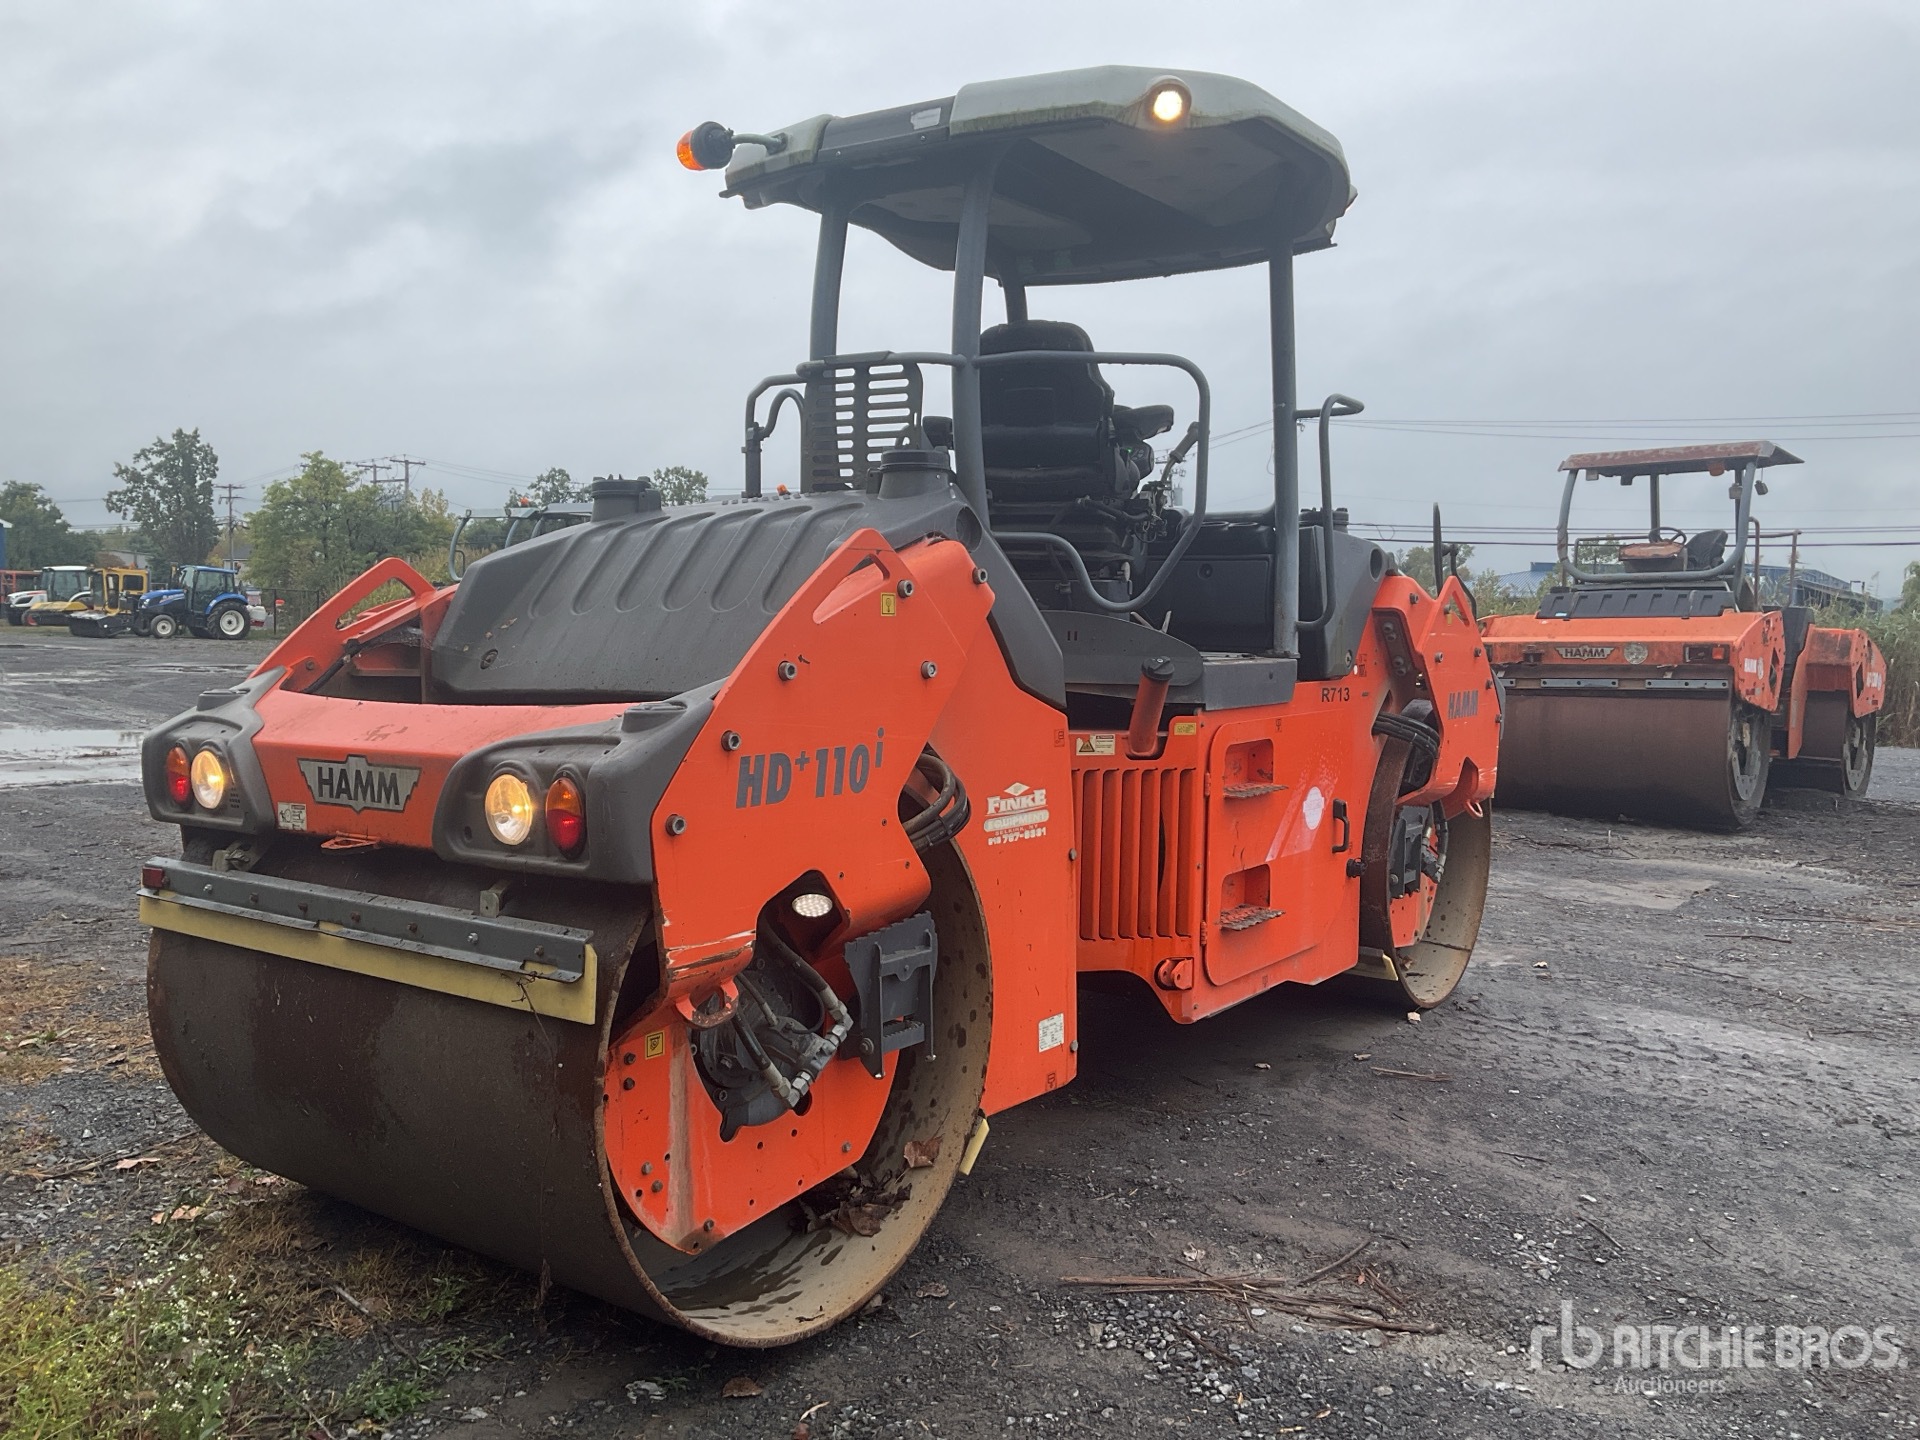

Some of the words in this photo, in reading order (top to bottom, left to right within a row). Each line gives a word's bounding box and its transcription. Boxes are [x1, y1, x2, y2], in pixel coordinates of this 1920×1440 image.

[1565, 648, 1605, 658] HAMM
[1321, 687, 1350, 702] R713
[1447, 690, 1479, 720] HAMM
[317, 766, 400, 806] HAMM
[987, 789, 1047, 815] FINKE
